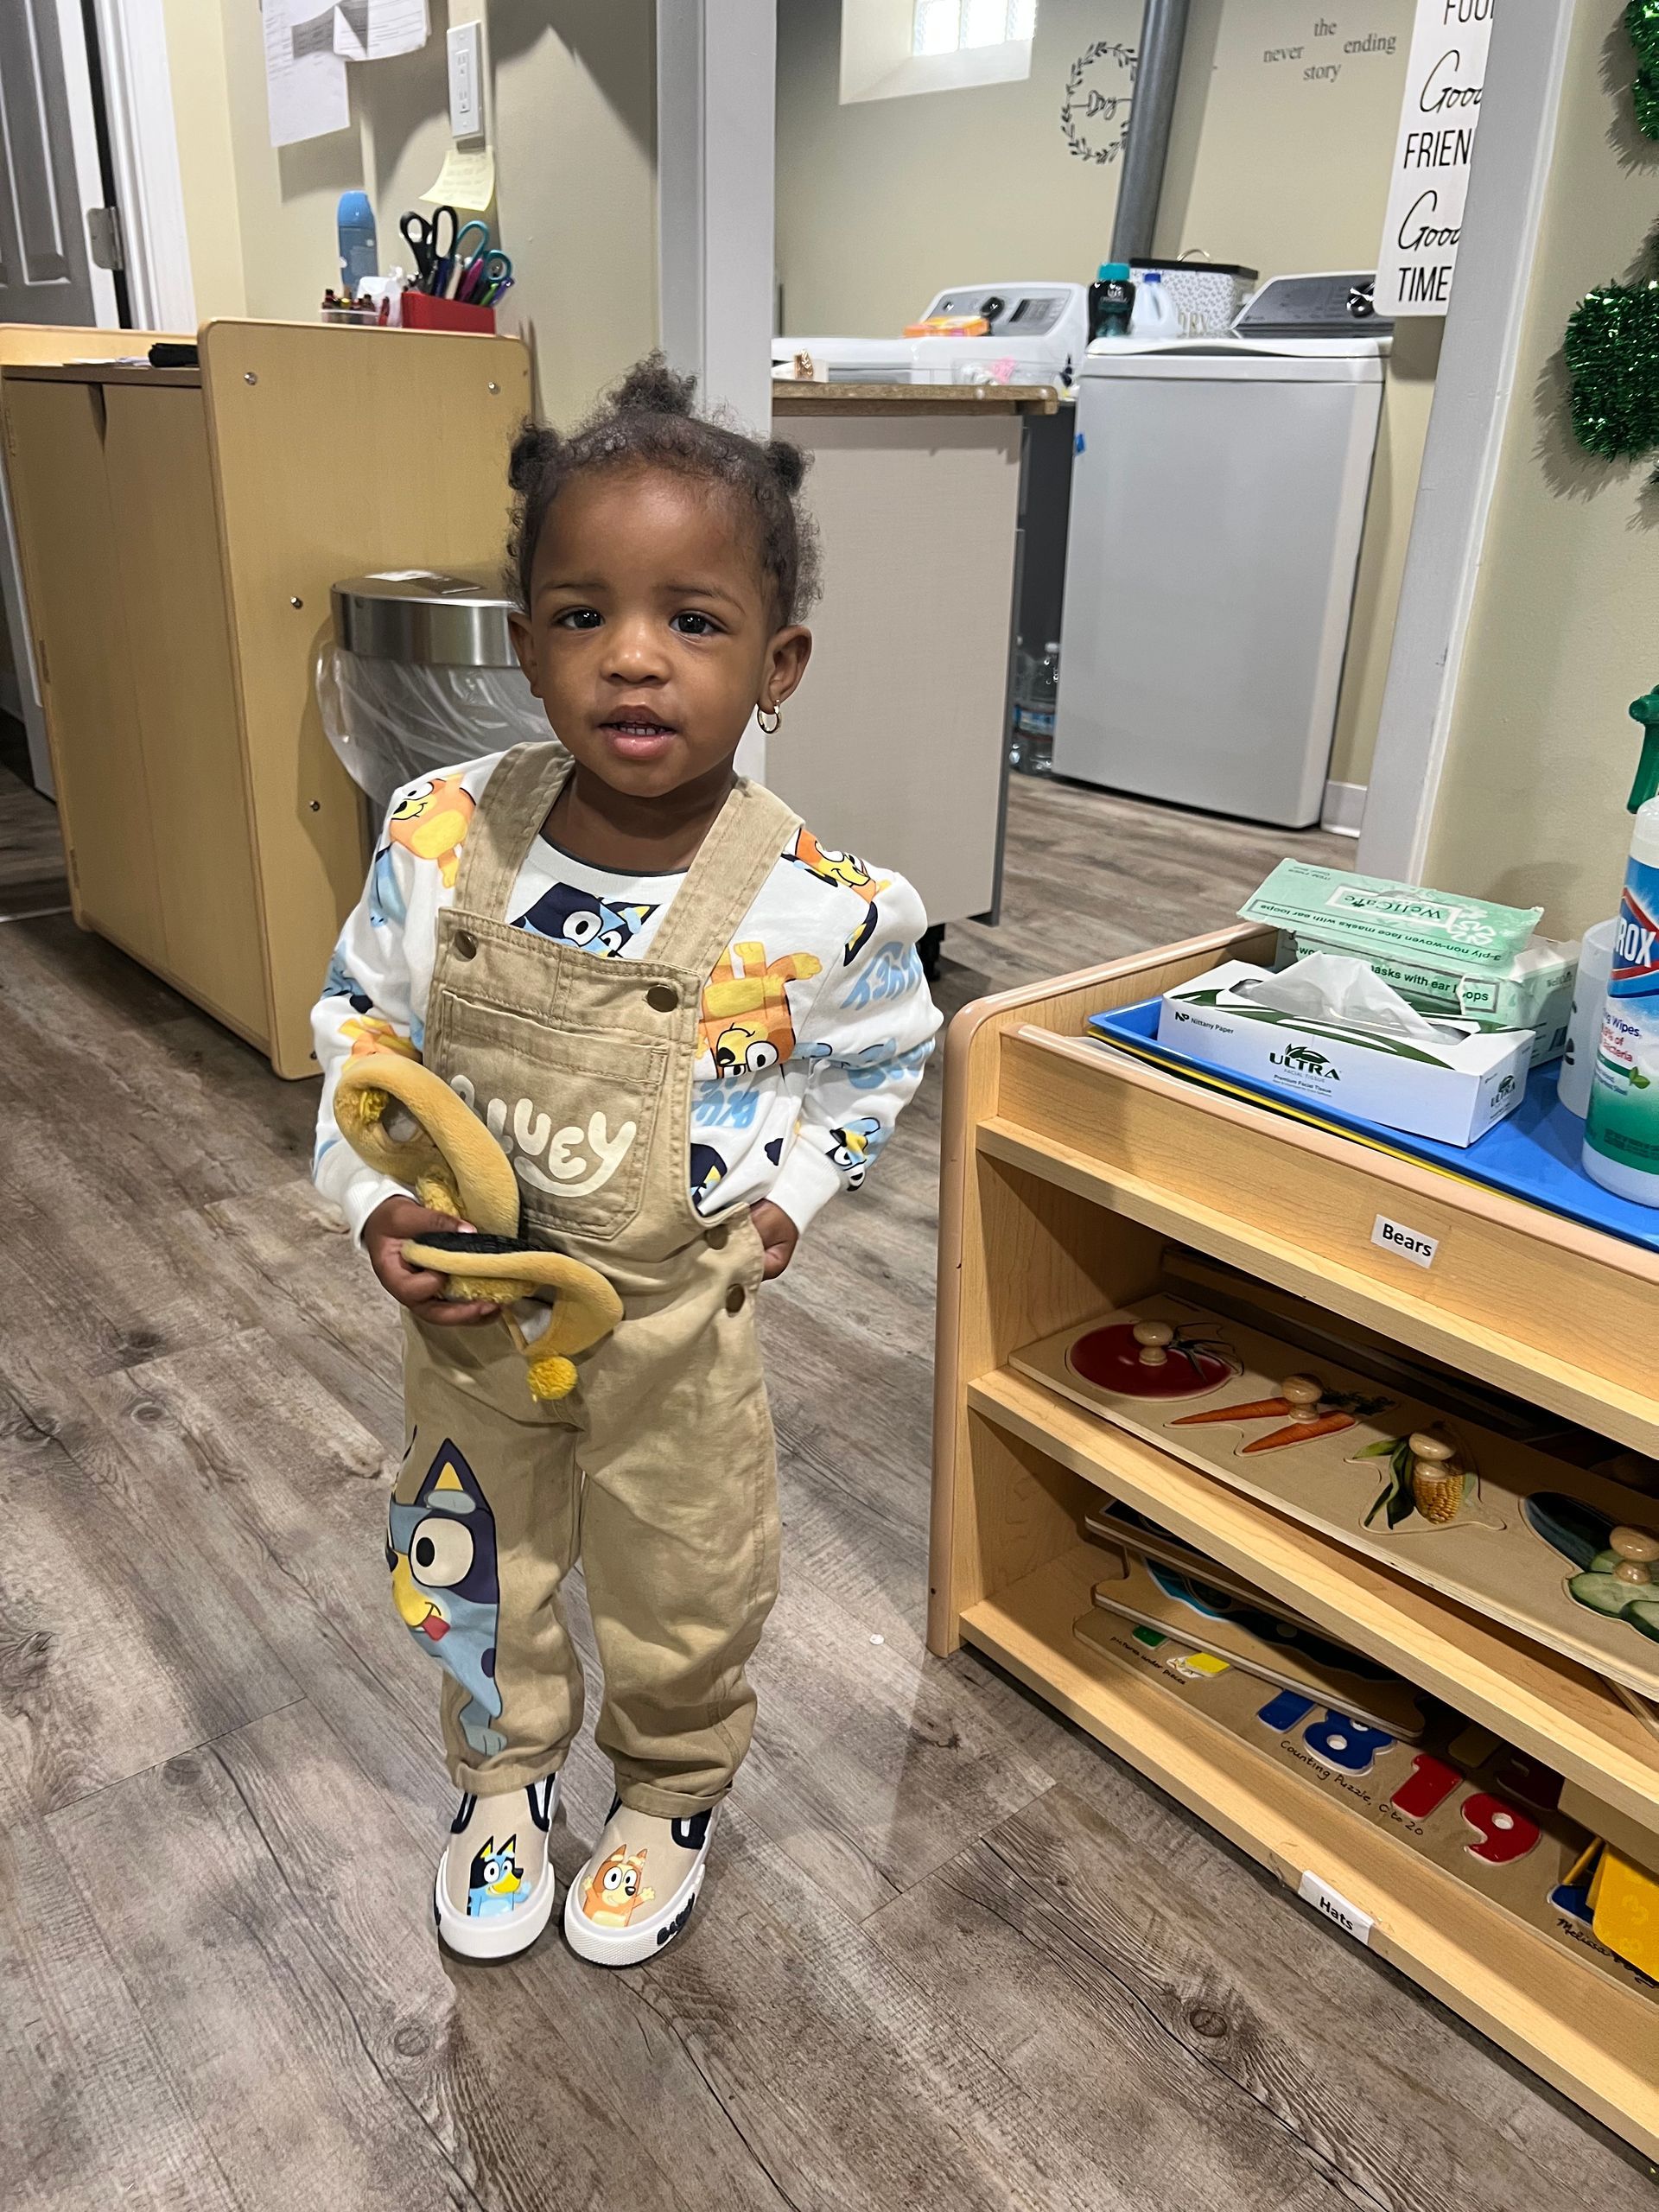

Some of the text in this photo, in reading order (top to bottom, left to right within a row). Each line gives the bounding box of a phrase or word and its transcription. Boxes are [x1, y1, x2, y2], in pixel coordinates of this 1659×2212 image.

[1444, 0, 1495, 25] FOO
[1313, 18, 1337, 37] the
[1263, 33, 1397, 63] never ending
[1303, 63, 1342, 83] story
[1343, 894, 1442, 920] WellCare
[1260, 903, 1502, 963] 3-ply non-woven face masks with ear loops
[1371, 964, 1489, 1001] asks with ear lops
[1191, 1018, 1215, 1031] Nittany
[1215, 1024, 1235, 1035] Paper
[1269, 1052, 1341, 1081] ULTRA
[1274, 1074, 1298, 1085] Premium
[1382, 1223, 1433, 1257] Bears
[1141, 1655, 1164, 1669] under
[1162, 1669, 1186, 1686] pieces
[1281, 1739, 1331, 1781] Counting
[1333, 1773, 1372, 1806] Puzzle,
[1390, 1810, 1403, 1823] to
[1405, 1821, 1424, 1836] 20
[1319, 1896, 1353, 1931] Hats
